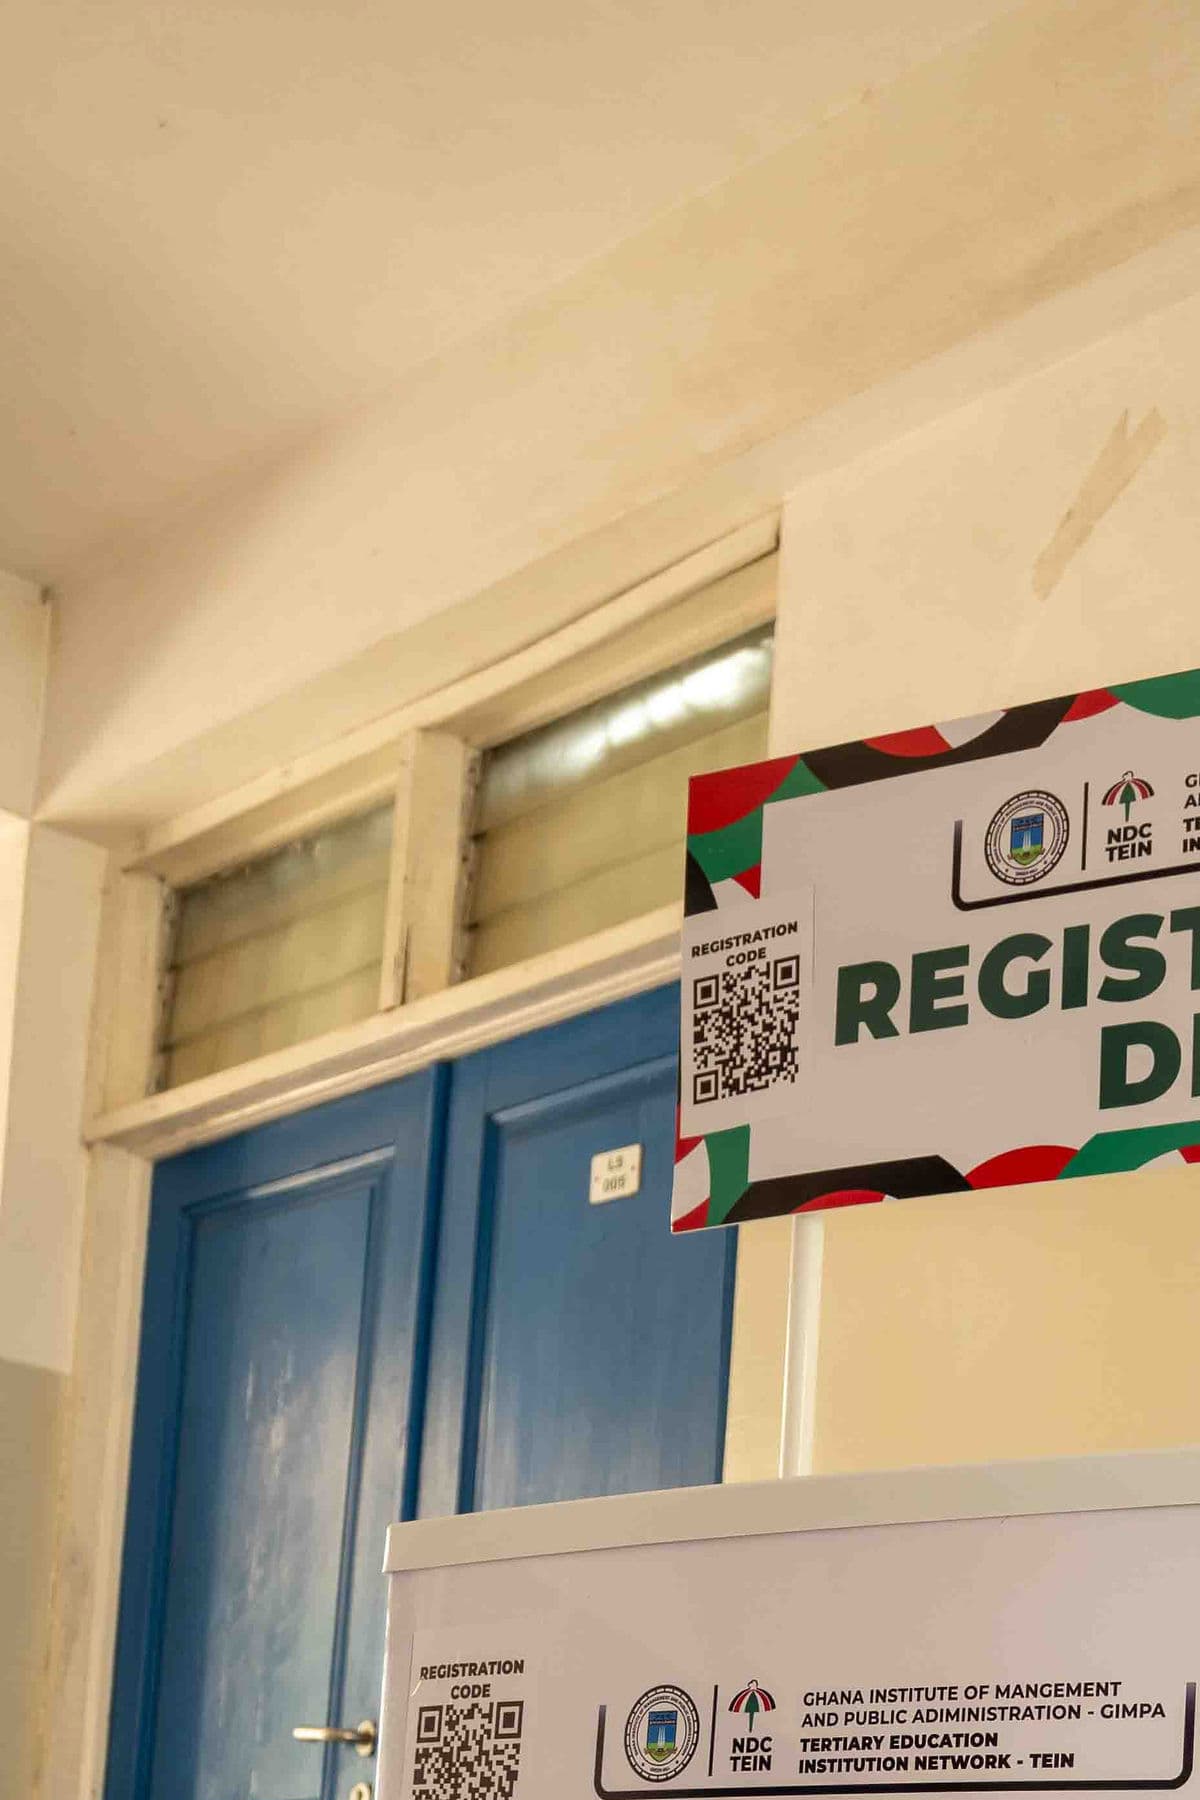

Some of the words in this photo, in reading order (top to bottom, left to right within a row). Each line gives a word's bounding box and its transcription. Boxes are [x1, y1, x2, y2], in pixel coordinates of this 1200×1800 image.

[1107, 823, 1152, 844] NDC
[1106, 840, 1152, 862] TEIN
[691, 920, 798, 958] REGISTRATION
[726, 947, 767, 967] CODE
[419, 1659, 525, 1680] REGISTRATION
[450, 1683, 491, 1700] CODE
[803, 1690, 864, 1707] GHANA
[869, 1686, 958, 1704] INSTITUTE
[964, 1684, 989, 1700] OF
[995, 1681, 1122, 1699] MANGEMENT
[801, 1711, 838, 1728] AND
[844, 1709, 907, 1726] PUBLIC
[912, 1704, 1081, 1723] ADIMINISTRATION
[1100, 1703, 1166, 1719] GIMPA
[732, 1737, 772, 1753] NDC
[800, 1735, 884, 1752] TERTIARY
[889, 1732, 998, 1749] EDUCATION
[730, 1755, 772, 1772] TEIN
[799, 1756, 908, 1774] INSTITUTION
[914, 1754, 1011, 1770] NETWORK
[1030, 1753, 1074, 1768] TEIN
